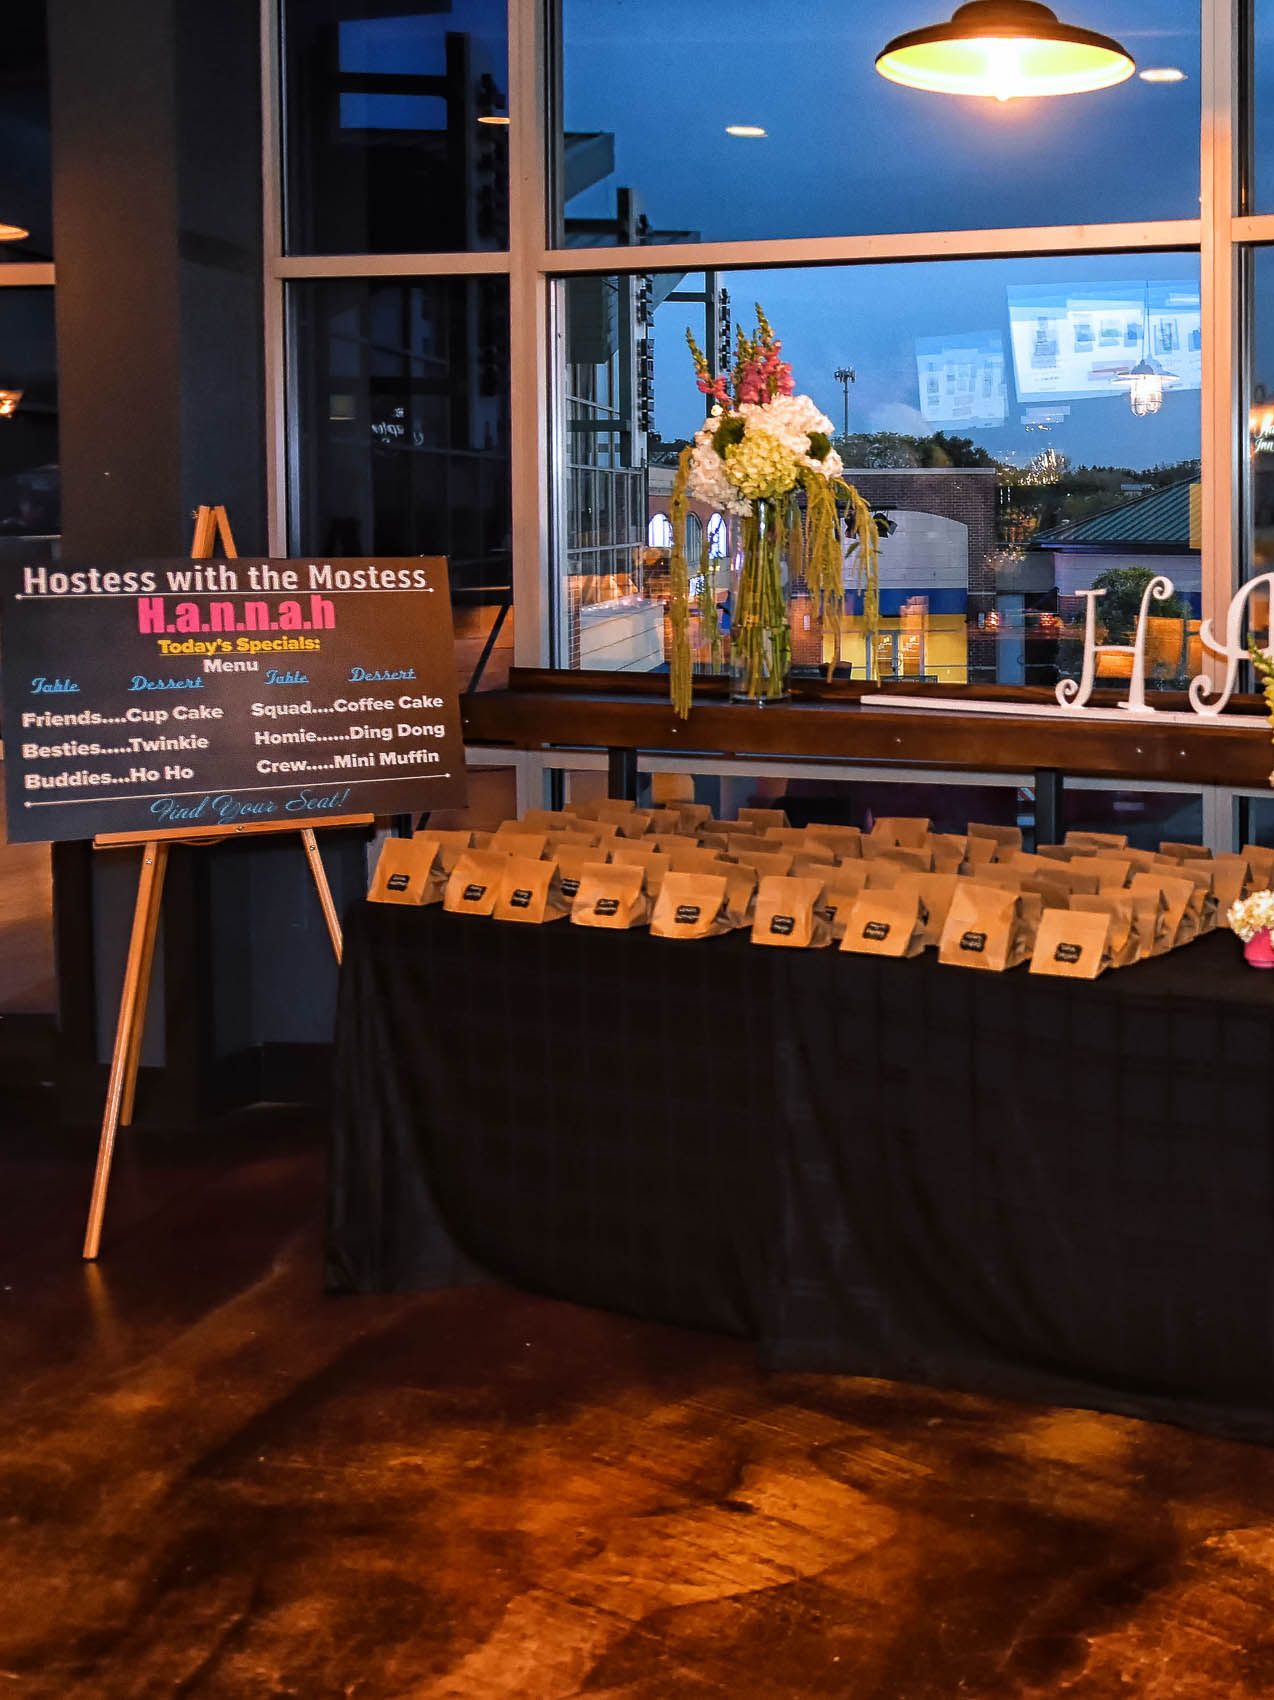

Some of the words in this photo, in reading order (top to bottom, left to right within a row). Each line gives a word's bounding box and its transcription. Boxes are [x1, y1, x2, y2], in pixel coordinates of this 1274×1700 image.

[23, 567, 156, 594] Hostess
[166, 565, 237, 591] with
[248, 565, 298, 590] the
[309, 565, 426, 589] Mostess
[138, 594, 336, 634] H.a.n.n.a.h
[157, 638, 233, 655] Today's
[236, 636, 321, 654] Specials:
[203, 659, 258, 673] Menu
[31, 677, 80, 693] Table
[128, 675, 204, 691] Dessert
[264, 669, 309, 685] Table
[349, 667, 416, 682] Dessert
[398, 695, 444, 709] Cake
[172, 705, 224, 720] Cake
[397, 724, 446, 738] Dong
[379, 749, 440, 766] Muffin
[164, 765, 195, 780] Ho
[150, 796, 211, 822] Find
[211, 794, 277, 825] Your
[285, 788, 350, 811] Seat!
